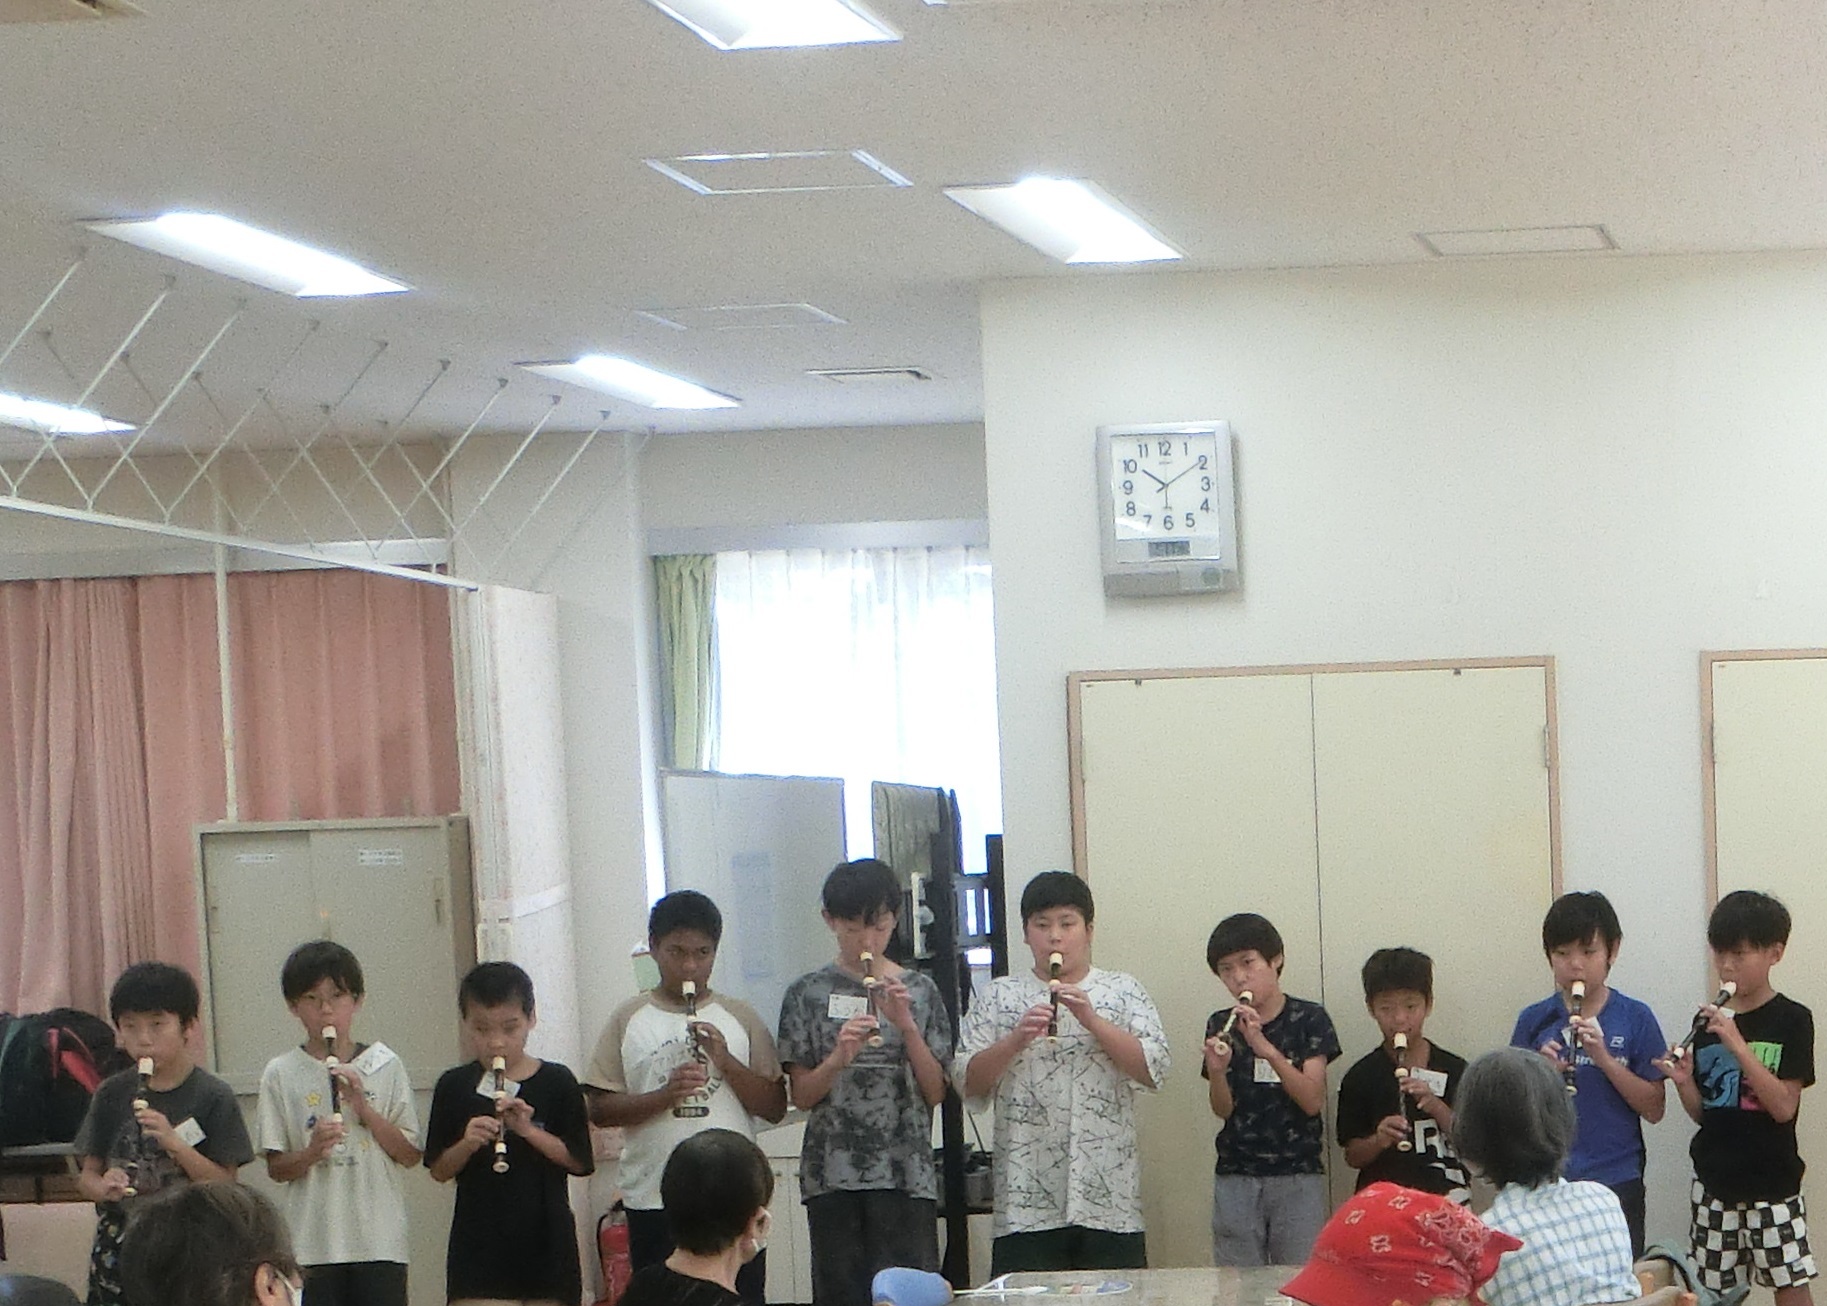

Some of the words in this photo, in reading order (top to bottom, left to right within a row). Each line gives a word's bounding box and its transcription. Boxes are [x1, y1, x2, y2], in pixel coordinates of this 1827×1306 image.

[1138, 444, 1148, 458] 11
[1158, 441, 1171, 456] 12
[1184, 442, 1188, 455] 1
[1123, 459, 1137, 473] 10
[1198, 455, 1208, 470] 2
[1123, 480, 1133, 495] 9
[1201, 476, 1211, 491] 3
[1126, 501, 1136, 516] 8
[1200, 498, 1210, 513] 4
[1143, 515, 1152, 527] 7
[1163, 515, 1174, 530] 6
[1185, 513, 1195, 528] 5
